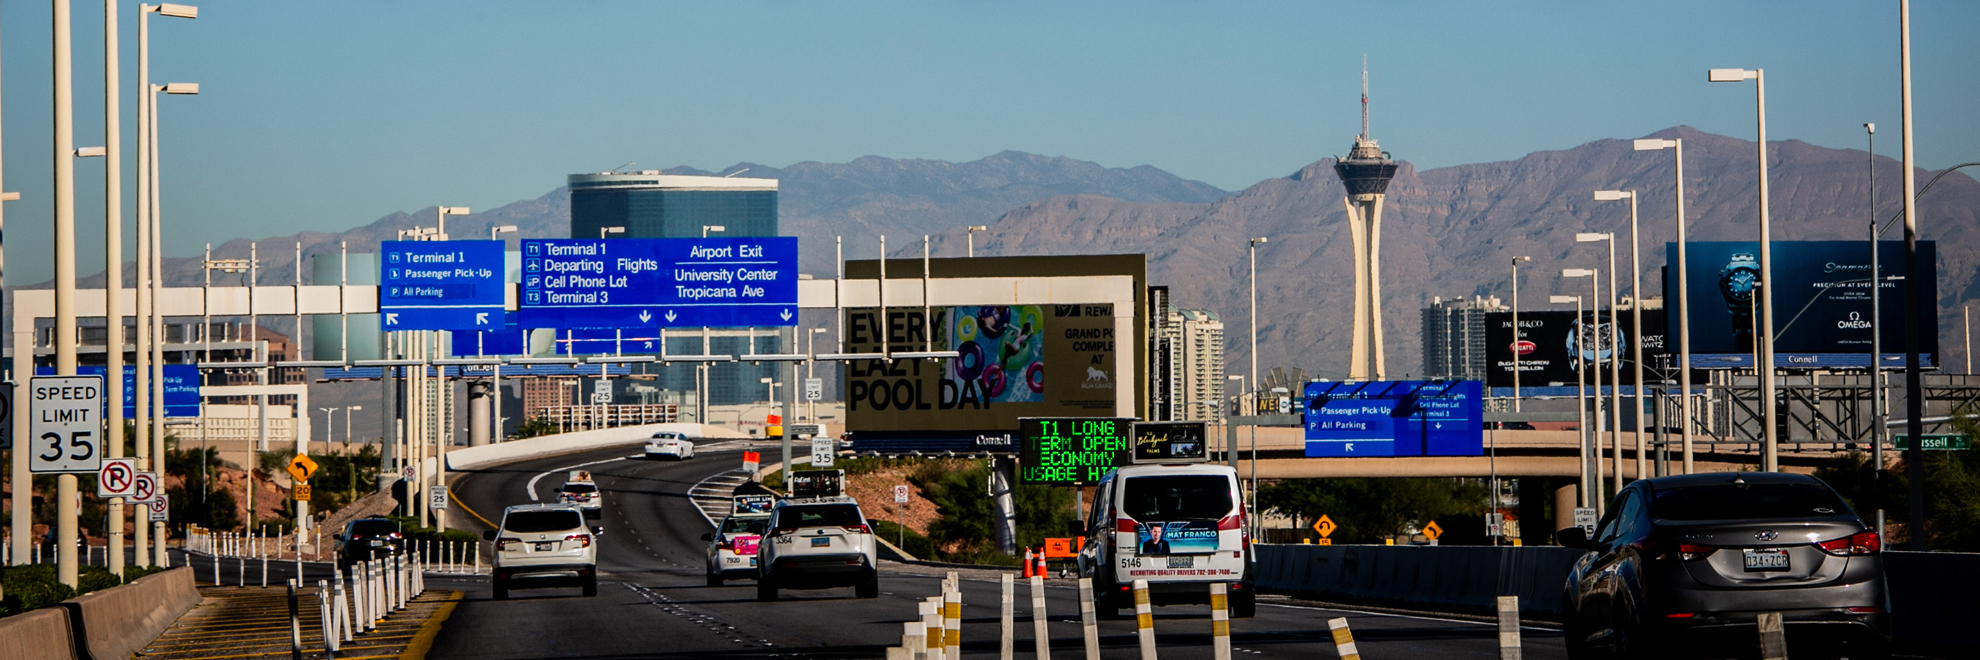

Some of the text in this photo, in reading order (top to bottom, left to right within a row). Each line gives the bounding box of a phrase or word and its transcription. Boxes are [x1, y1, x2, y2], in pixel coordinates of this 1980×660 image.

[545, 243, 596, 255] Terminal
[600, 243, 606, 255] 1
[690, 245, 762, 260] Airport Exit
[406, 252, 454, 262] Terminal
[458, 252, 464, 262] 1
[545, 258, 658, 274] Departing Flights
[405, 269, 492, 279] Passenger Pick-Up
[675, 268, 778, 284] University Center
[545, 275, 566, 288] Cell
[570, 275, 606, 288] Phone
[610, 275, 627, 288] Lot
[404, 287, 413, 296] All
[416, 287, 443, 298] Parking
[545, 291, 597, 303] Terminal
[600, 291, 608, 303] 3
[676, 285, 764, 300] Tropicana Ave
[851, 312, 946, 343] EVERY
[1838, 320, 1872, 328] OMEGA
[1065, 329, 1100, 339] GRAND
[1091, 355, 1104, 364] AT
[1788, 355, 1818, 363] Connell
[36, 386, 96, 400] SPEED
[851, 379, 997, 411] POOL DAY
[42, 409, 89, 422] LIMIT
[1321, 406, 1391, 415] Passenger Pick-Up
[1040, 421, 1114, 435] T1 LONG
[1336, 421, 1366, 430] Parking
[39, 431, 94, 462] 35
[1029, 436, 1126, 450] TERM OPEN
[815, 454, 831, 463] 35
[1040, 451, 1114, 466] ECONOMY
[1024, 467, 1118, 481] USAGE HI
[296, 487, 309, 495] 20
[776, 536, 792, 544] 3364
[1121, 558, 1141, 568] 5146
